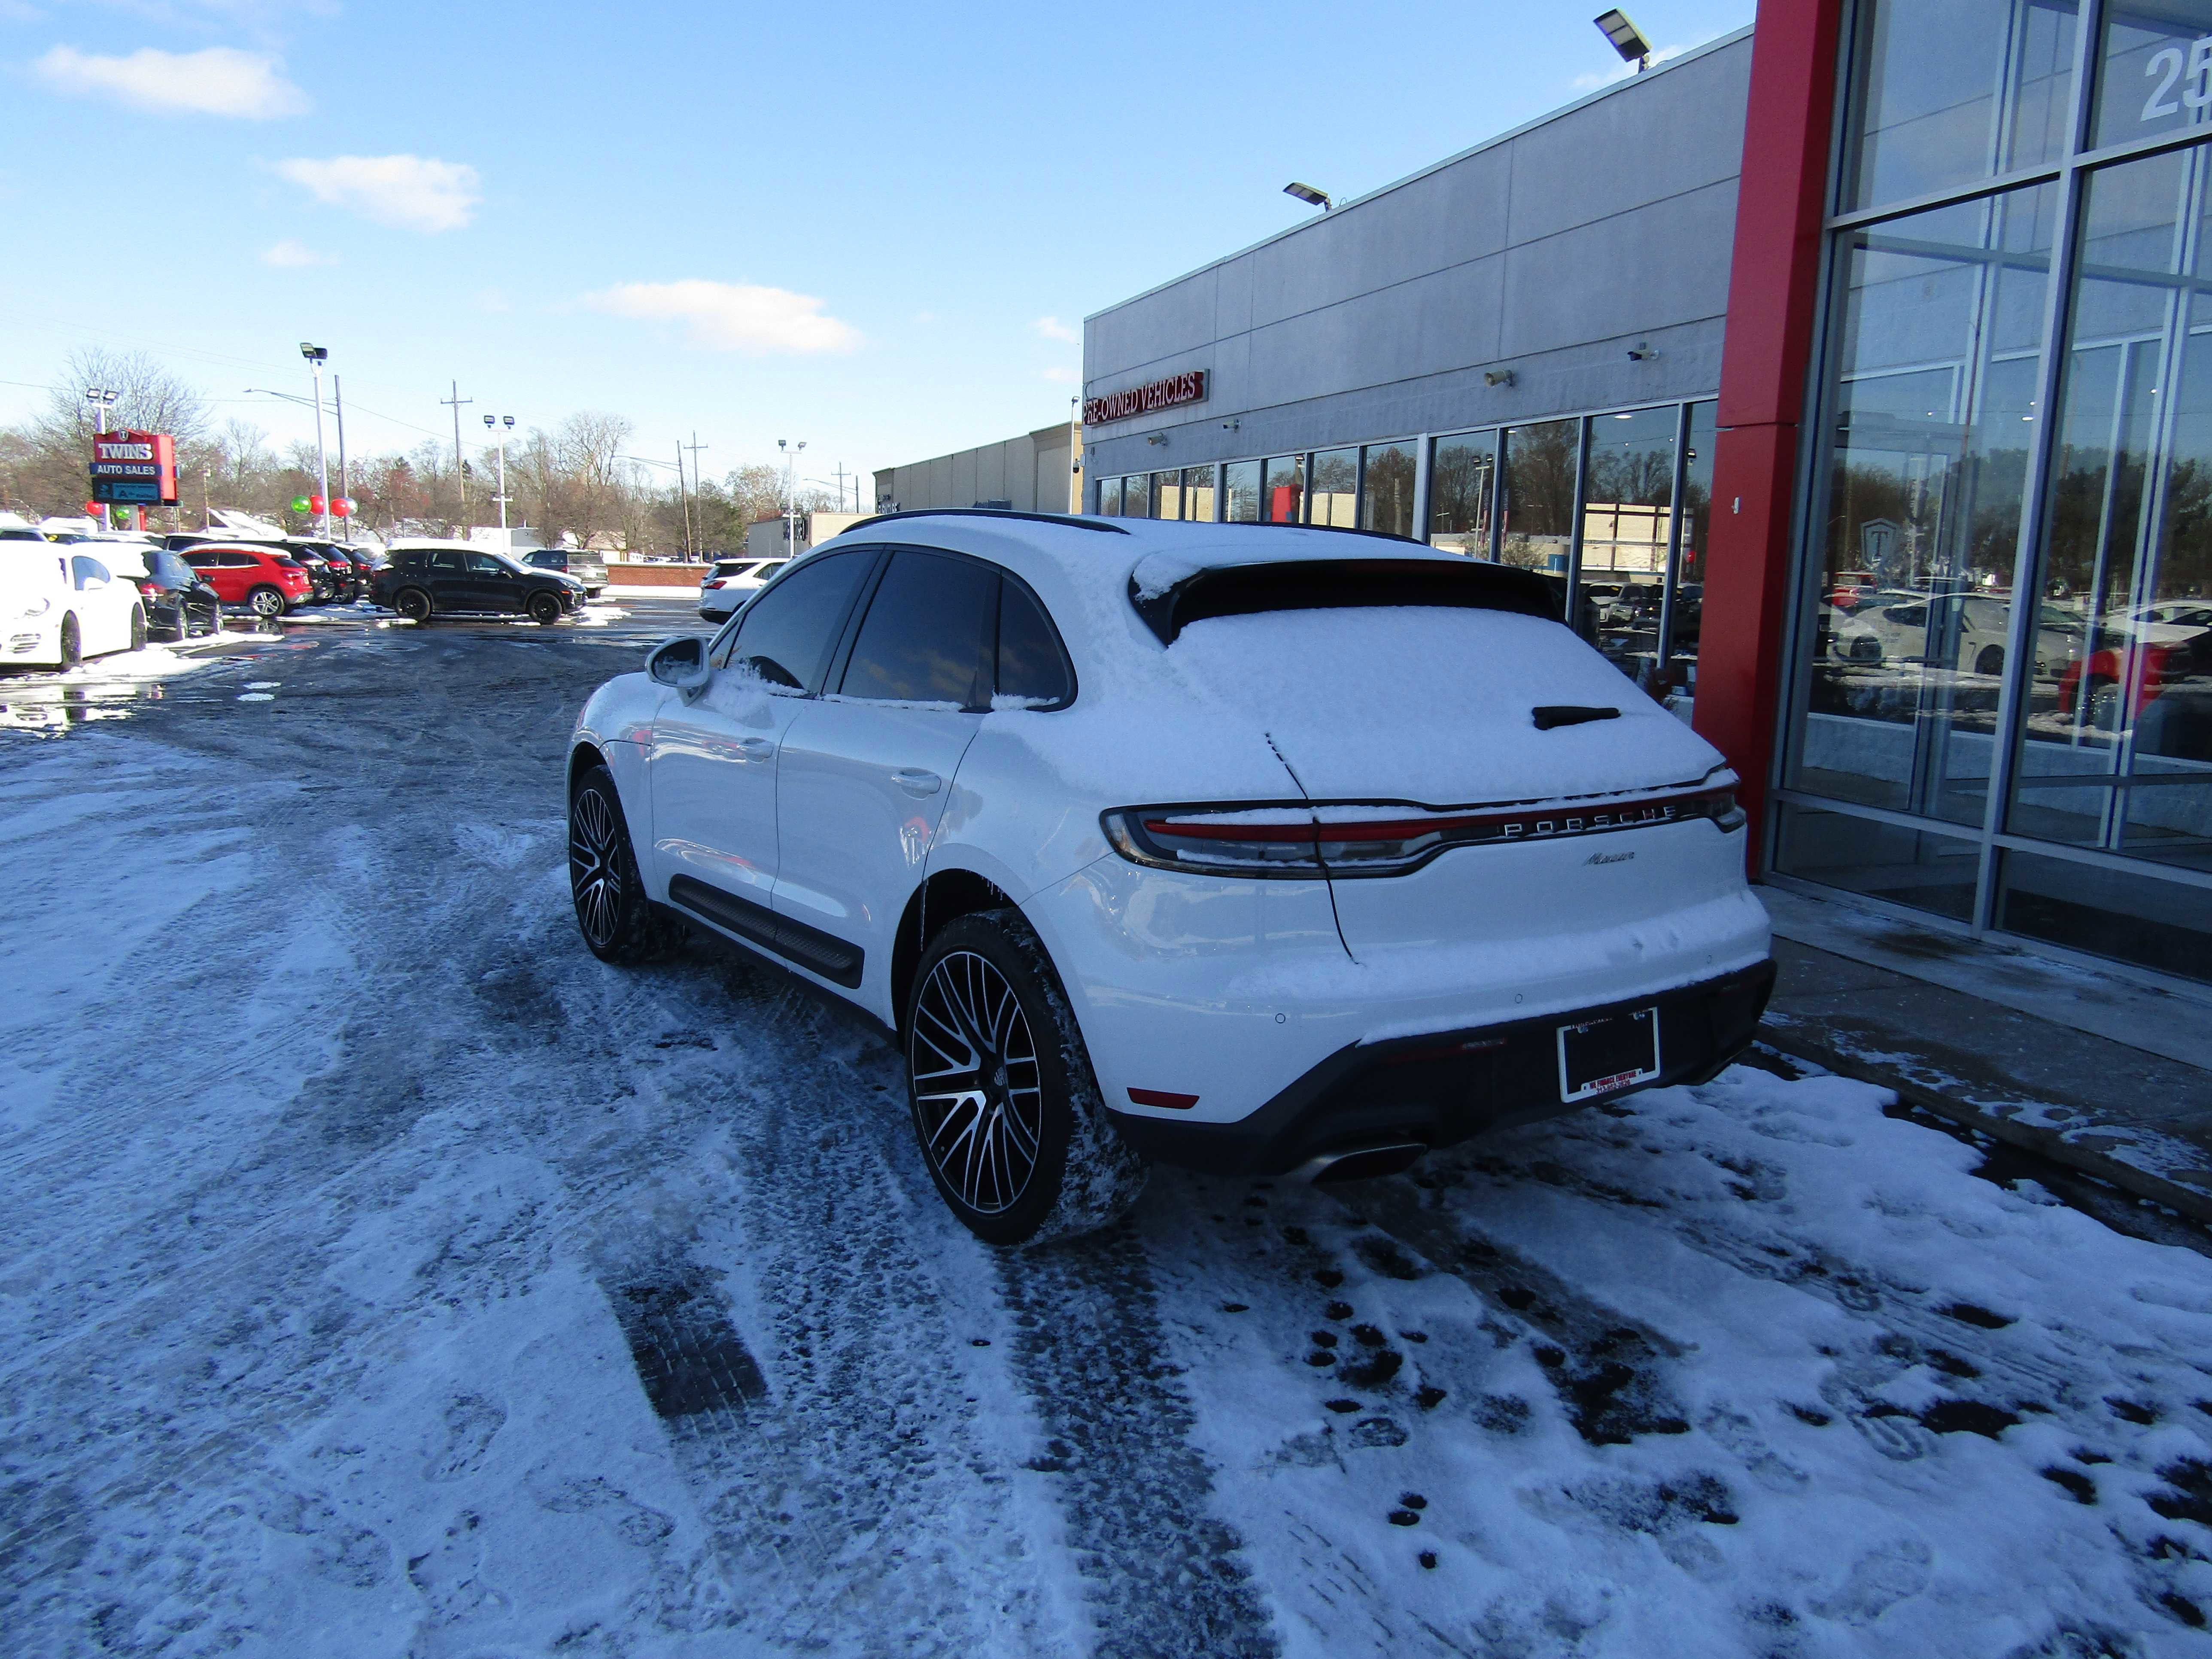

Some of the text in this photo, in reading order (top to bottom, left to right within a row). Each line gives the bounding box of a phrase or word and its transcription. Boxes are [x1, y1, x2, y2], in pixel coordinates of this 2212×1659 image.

[2140, 36, 2212, 122] 25
[1083, 372, 1195, 425] PRE-OWNED VEHICLES
[98, 443, 153, 460] TWINS
[97, 465, 155, 475] AUTO SALES
[1504, 806, 1676, 837] PORSCHE
